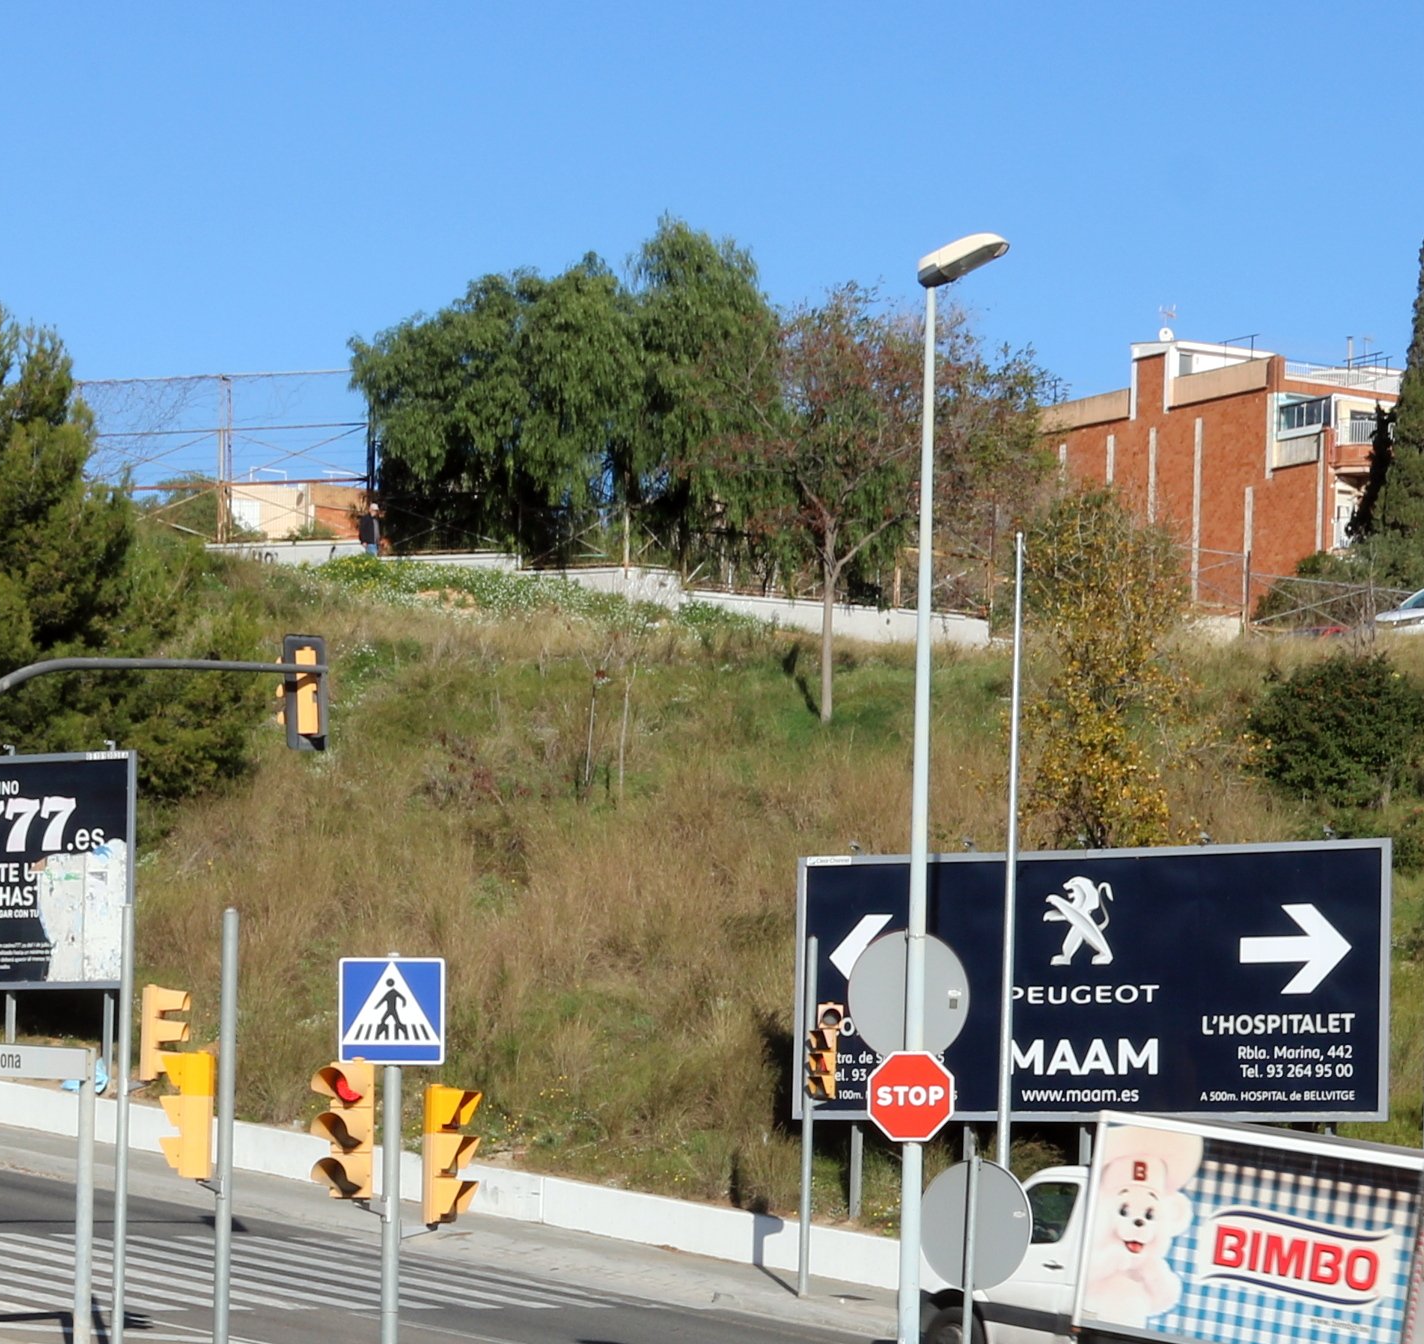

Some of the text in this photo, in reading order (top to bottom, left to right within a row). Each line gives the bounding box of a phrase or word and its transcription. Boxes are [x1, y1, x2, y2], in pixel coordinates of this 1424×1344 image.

[14, 910, 29, 919] CON
[1012, 985, 1160, 1005] PEUGEOT
[1202, 1013, 1355, 1035] L'HOSPITALET
[836, 1052, 856, 1064] tra.
[858, 1051, 873, 1064] de
[1011, 1038, 1159, 1076] MAAM
[1237, 1045, 1353, 1061] Rbla. Marina, 442
[851, 1069, 867, 1082] 93
[1240, 1064, 1354, 1078] Tel. 93 264 95 00
[876, 1085, 945, 1107] STOP
[1021, 1088, 1140, 1102] www.maam.es
[1200, 1090, 1356, 1102] A 500m. HOSPITAL de BELLVITGE
[1212, 1225, 1380, 1293] BIMBO
